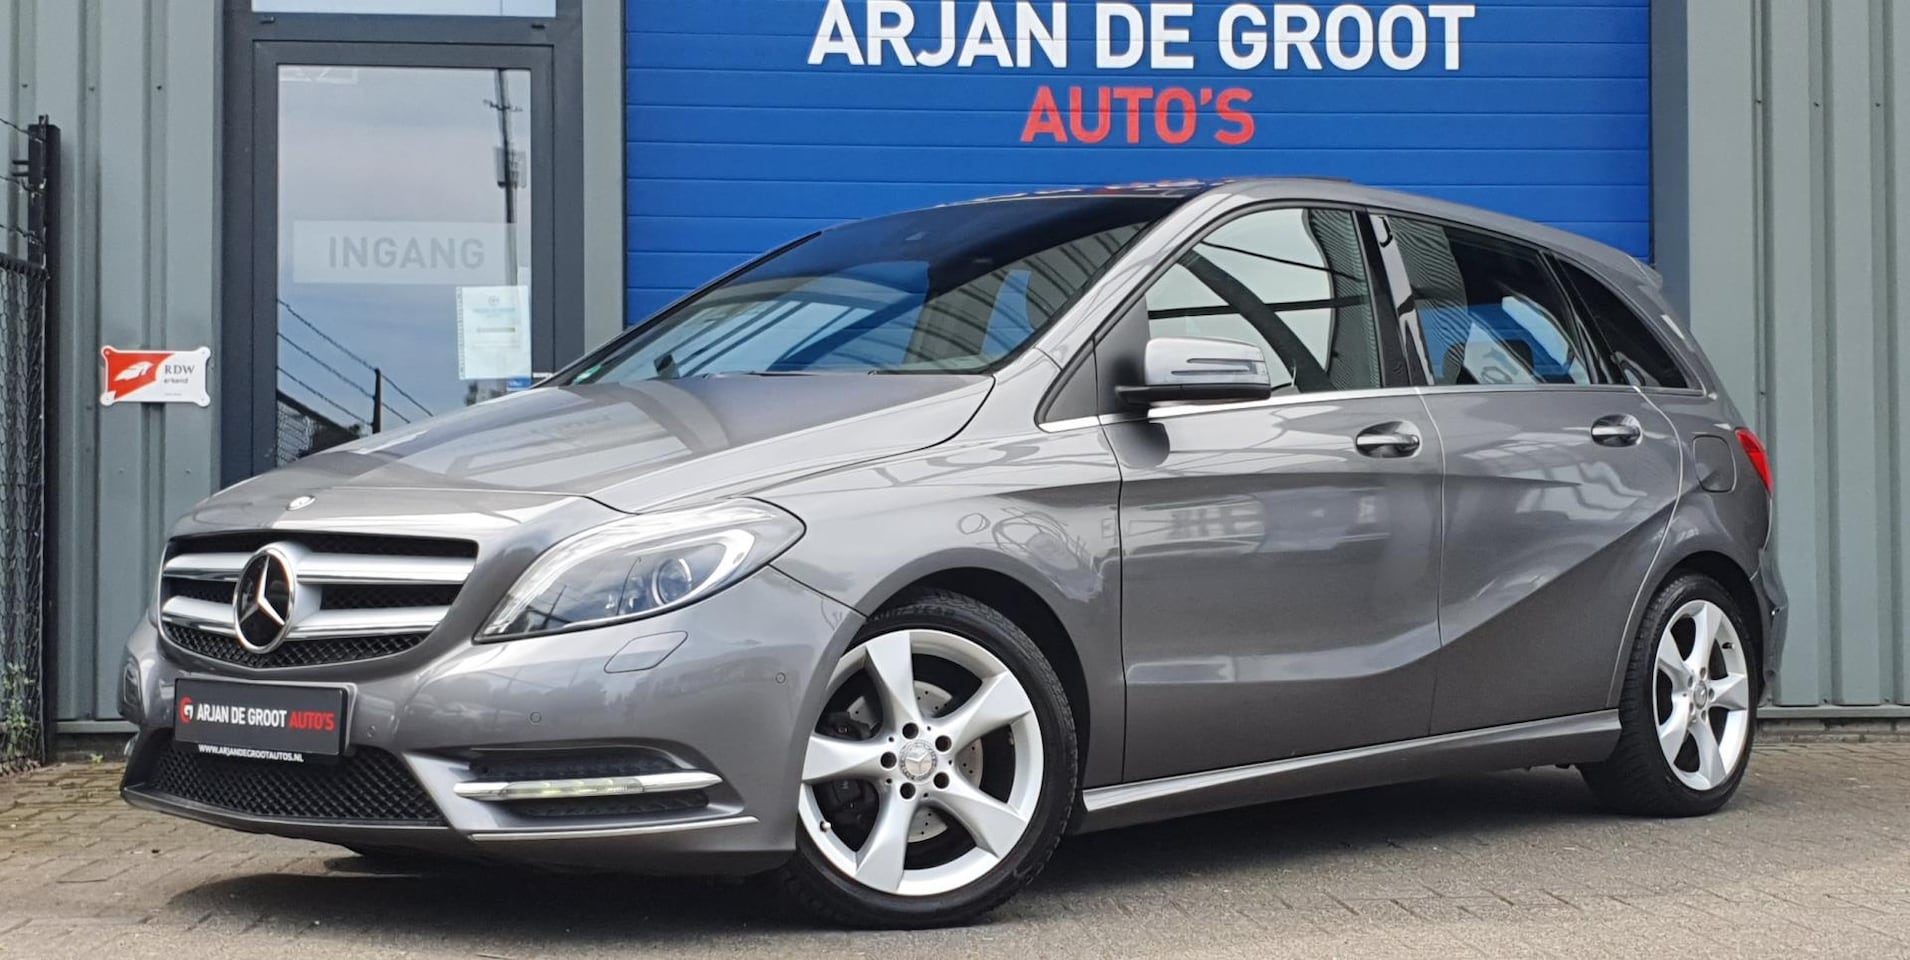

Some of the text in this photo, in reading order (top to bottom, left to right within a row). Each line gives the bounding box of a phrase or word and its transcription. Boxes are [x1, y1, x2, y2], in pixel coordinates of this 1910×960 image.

[807, 0, 1475, 71] ARJAN DE GROOT
[1020, 86, 1255, 144] AUTO'S
[328, 235, 485, 269] INGANG
[164, 364, 195, 375] RDW
[197, 703, 335, 731] ARJAN DE GROOT AUTO'S
[198, 744, 304, 762] WWW.ARJANDEGROOTAUTOS.NL
